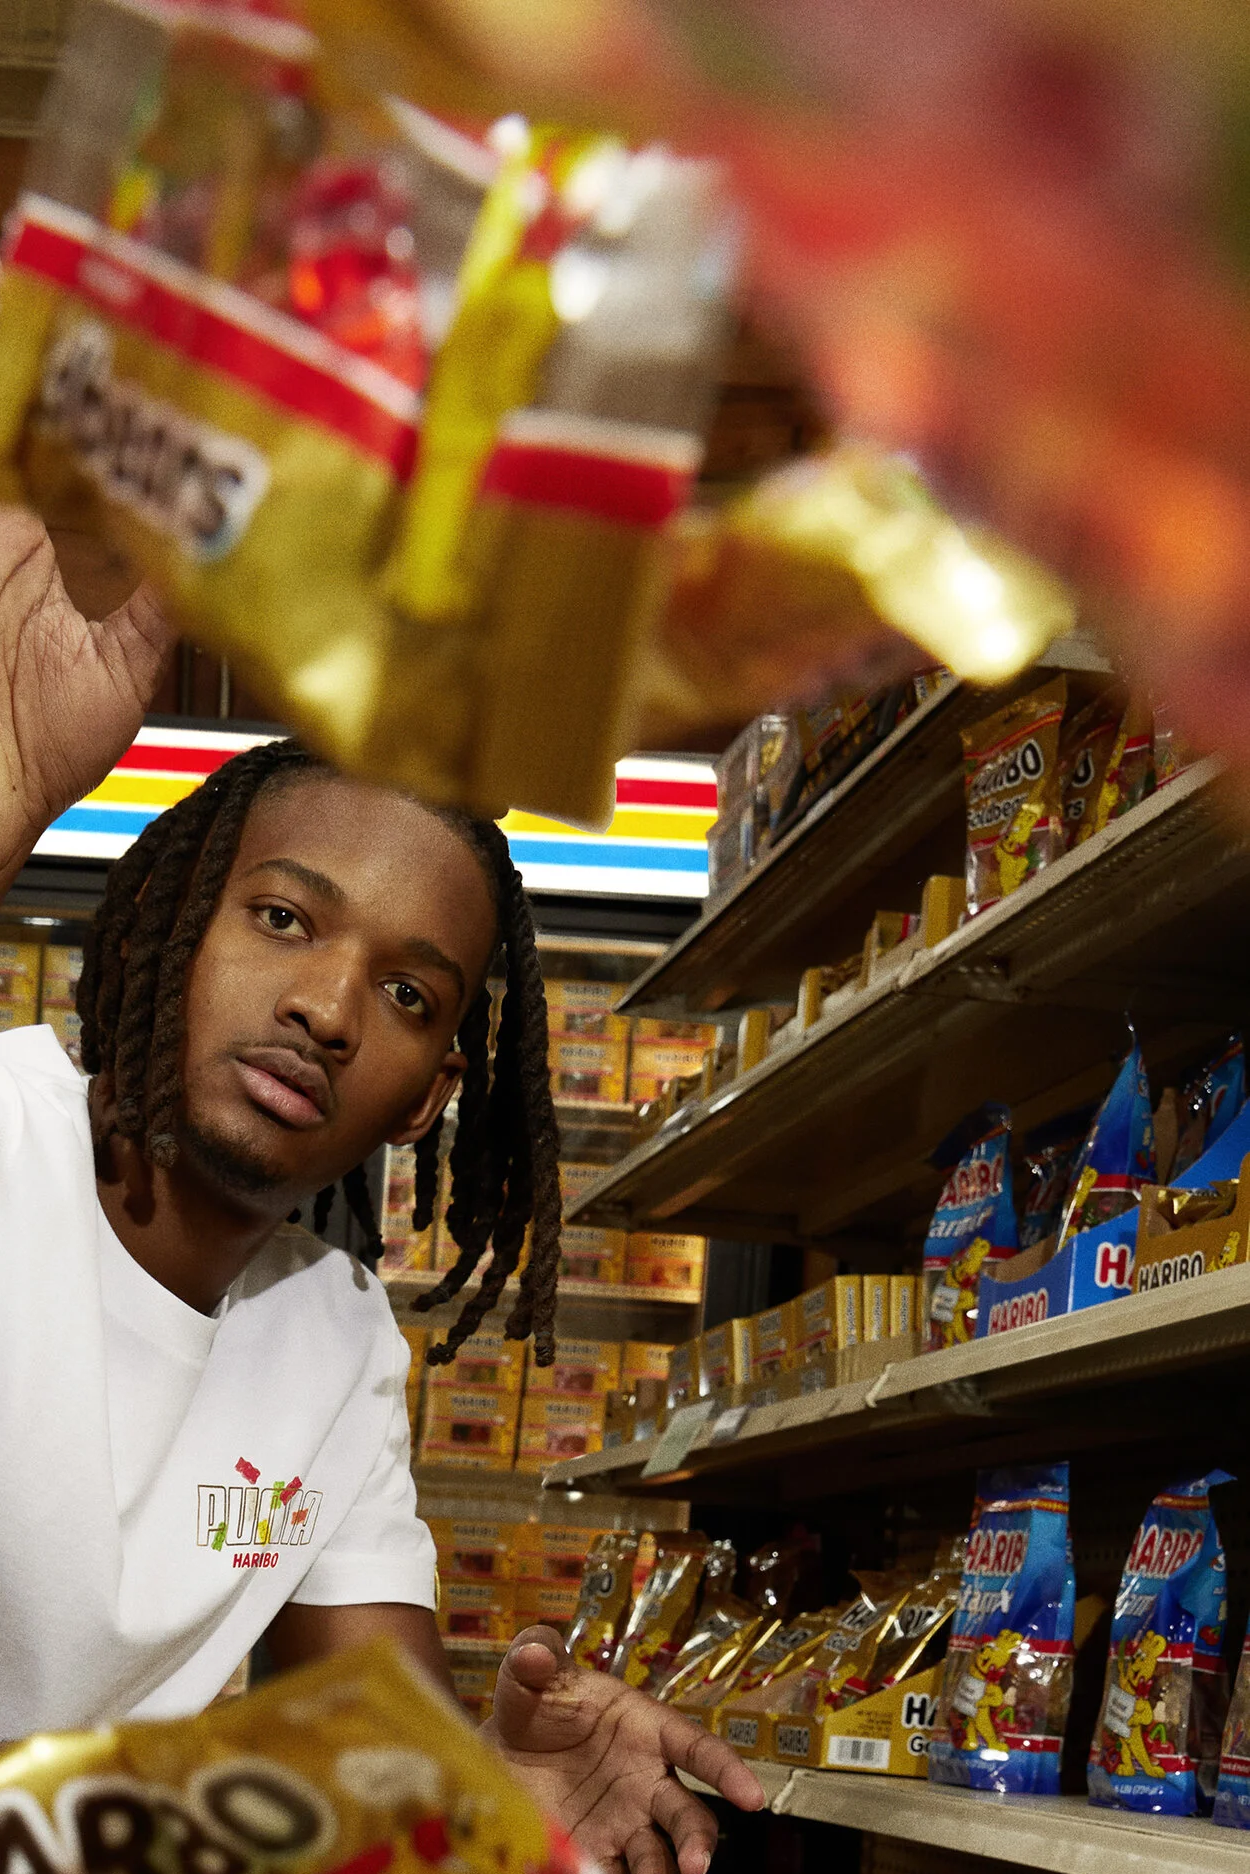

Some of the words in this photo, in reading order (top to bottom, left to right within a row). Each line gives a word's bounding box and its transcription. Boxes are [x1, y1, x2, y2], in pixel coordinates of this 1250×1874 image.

[1138, 1250, 1206, 1292] HARIBO
[988, 1287, 1049, 1336] HARIBO
[196, 1484, 324, 1547] PUMA
[232, 1552, 279, 1569] HARIBO
